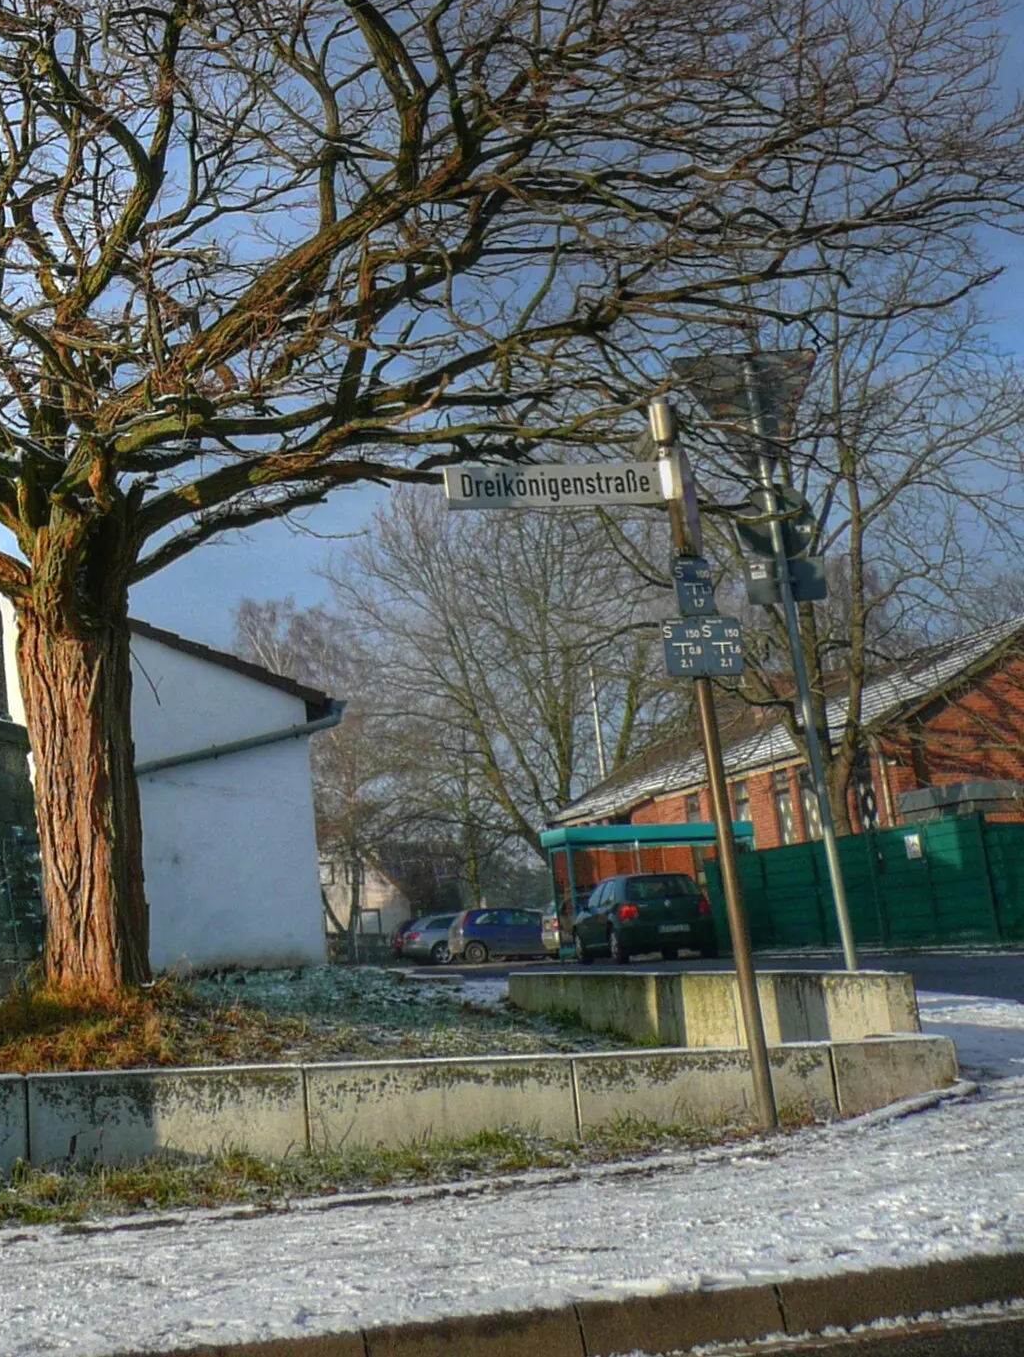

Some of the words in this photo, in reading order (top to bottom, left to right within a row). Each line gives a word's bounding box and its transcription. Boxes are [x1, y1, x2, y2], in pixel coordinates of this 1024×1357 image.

[461, 469, 650, 502] Dreikönigenstraße
[674, 566, 684, 579] S
[662, 626, 673, 638] S
[701, 625, 712, 638] S
